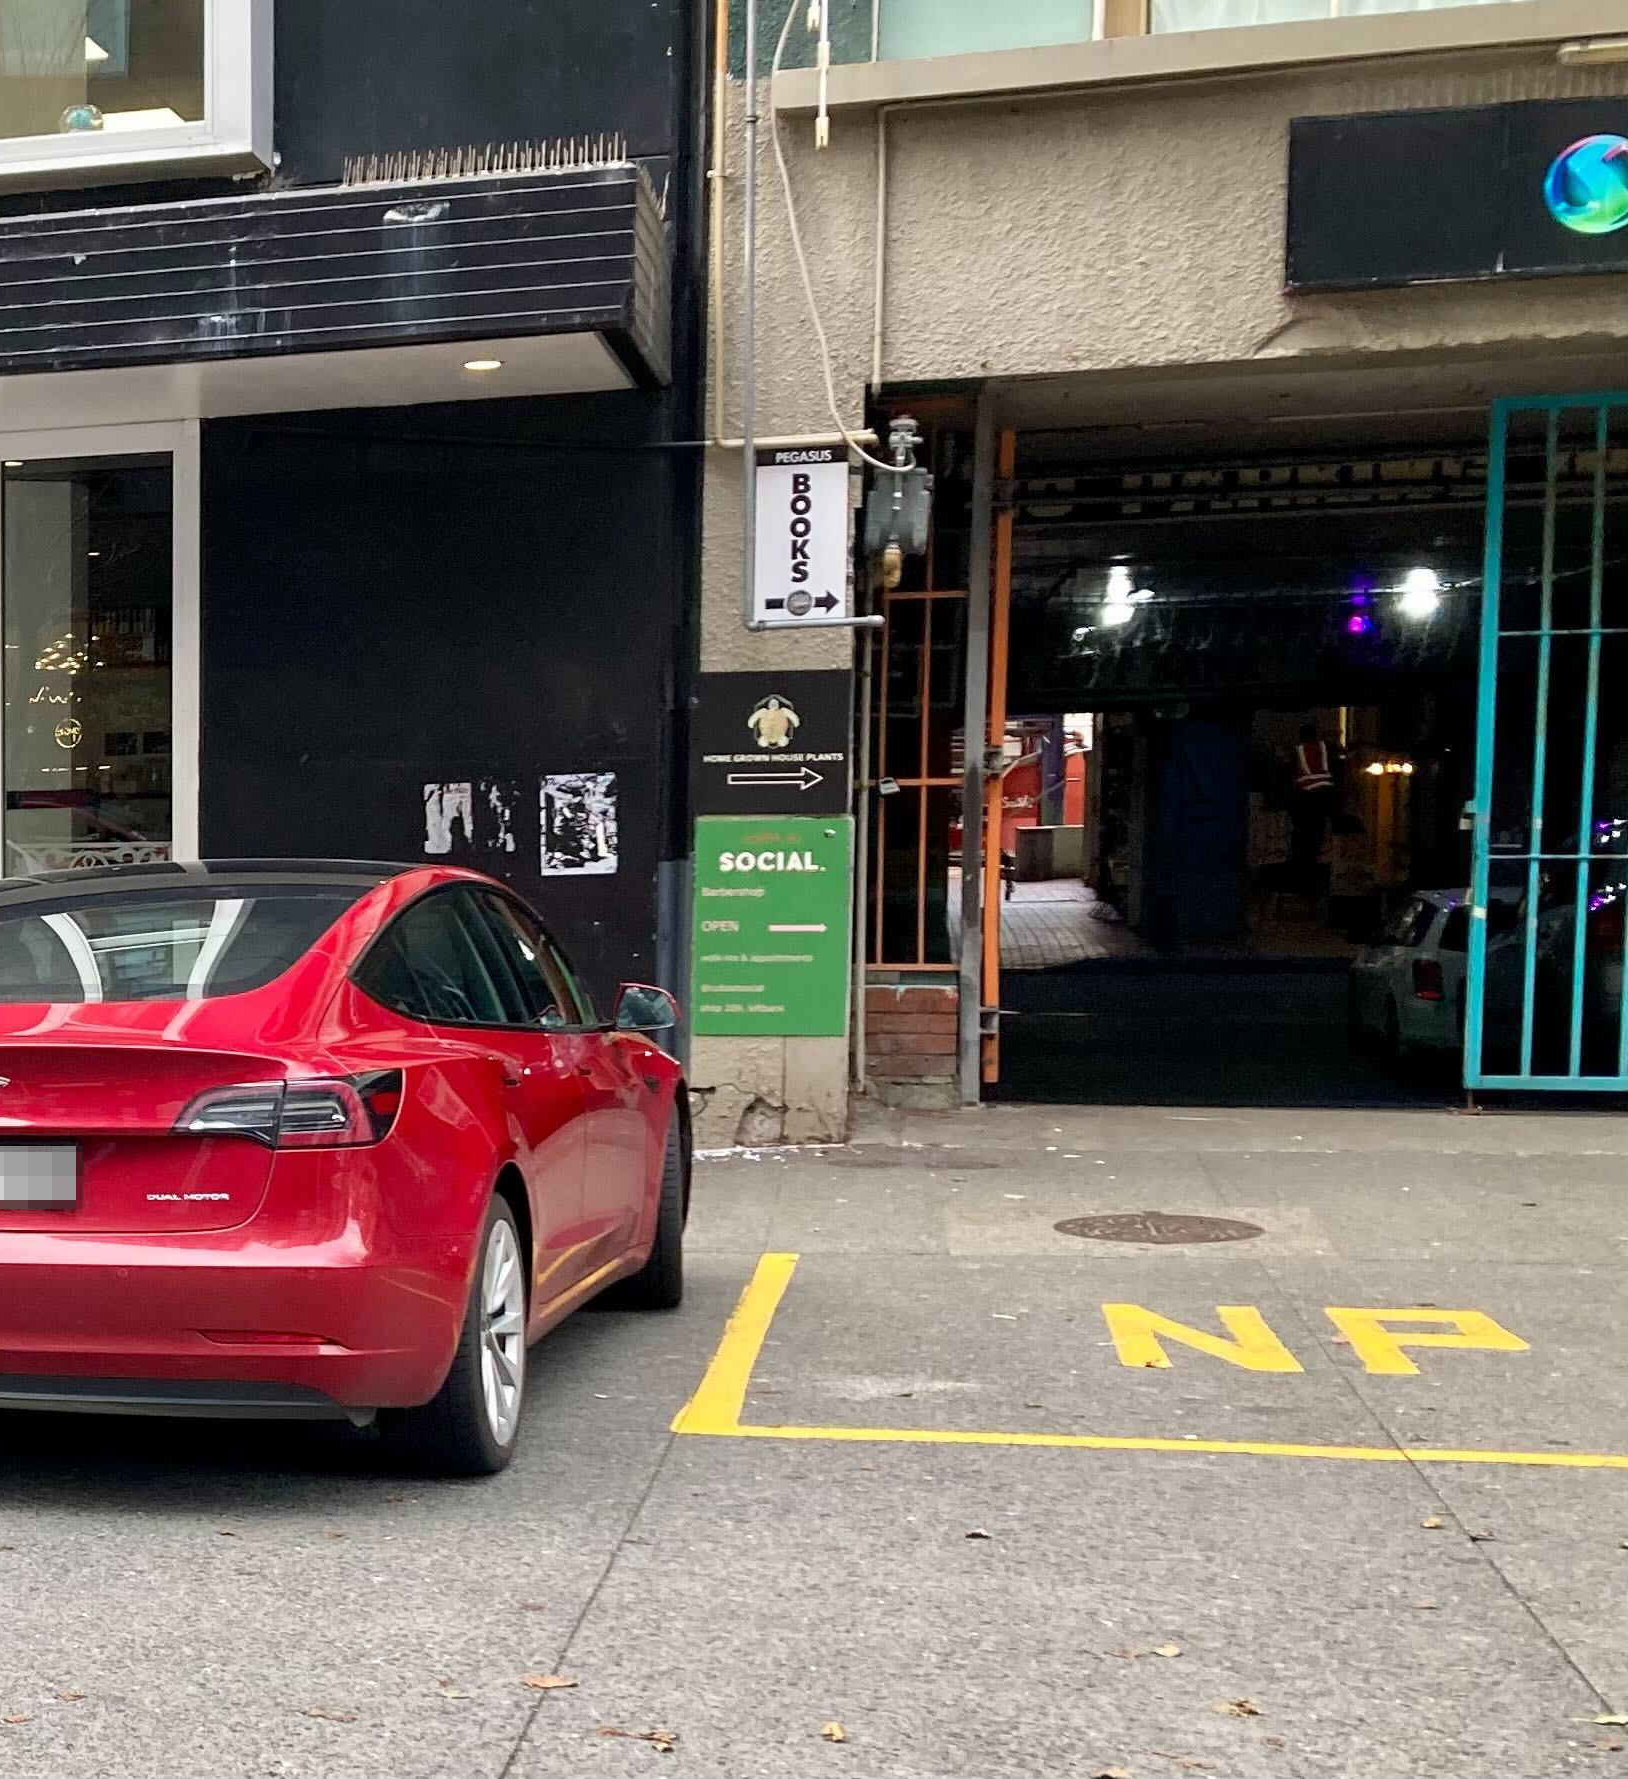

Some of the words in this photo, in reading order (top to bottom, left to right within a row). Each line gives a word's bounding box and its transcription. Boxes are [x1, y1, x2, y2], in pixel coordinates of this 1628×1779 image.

[775, 450, 832, 464] PEGASUS
[789, 473, 812, 583] BOOKS
[703, 755, 732, 763] HOME
[733, 754, 770, 763] GROWN
[771, 754, 804, 762] HOUSE
[805, 752, 844, 761] PLANTS
[701, 920, 740, 932] OPEN
[146, 1193, 182, 1201] DUAL
[183, 1193, 230, 1201] MOTOR
